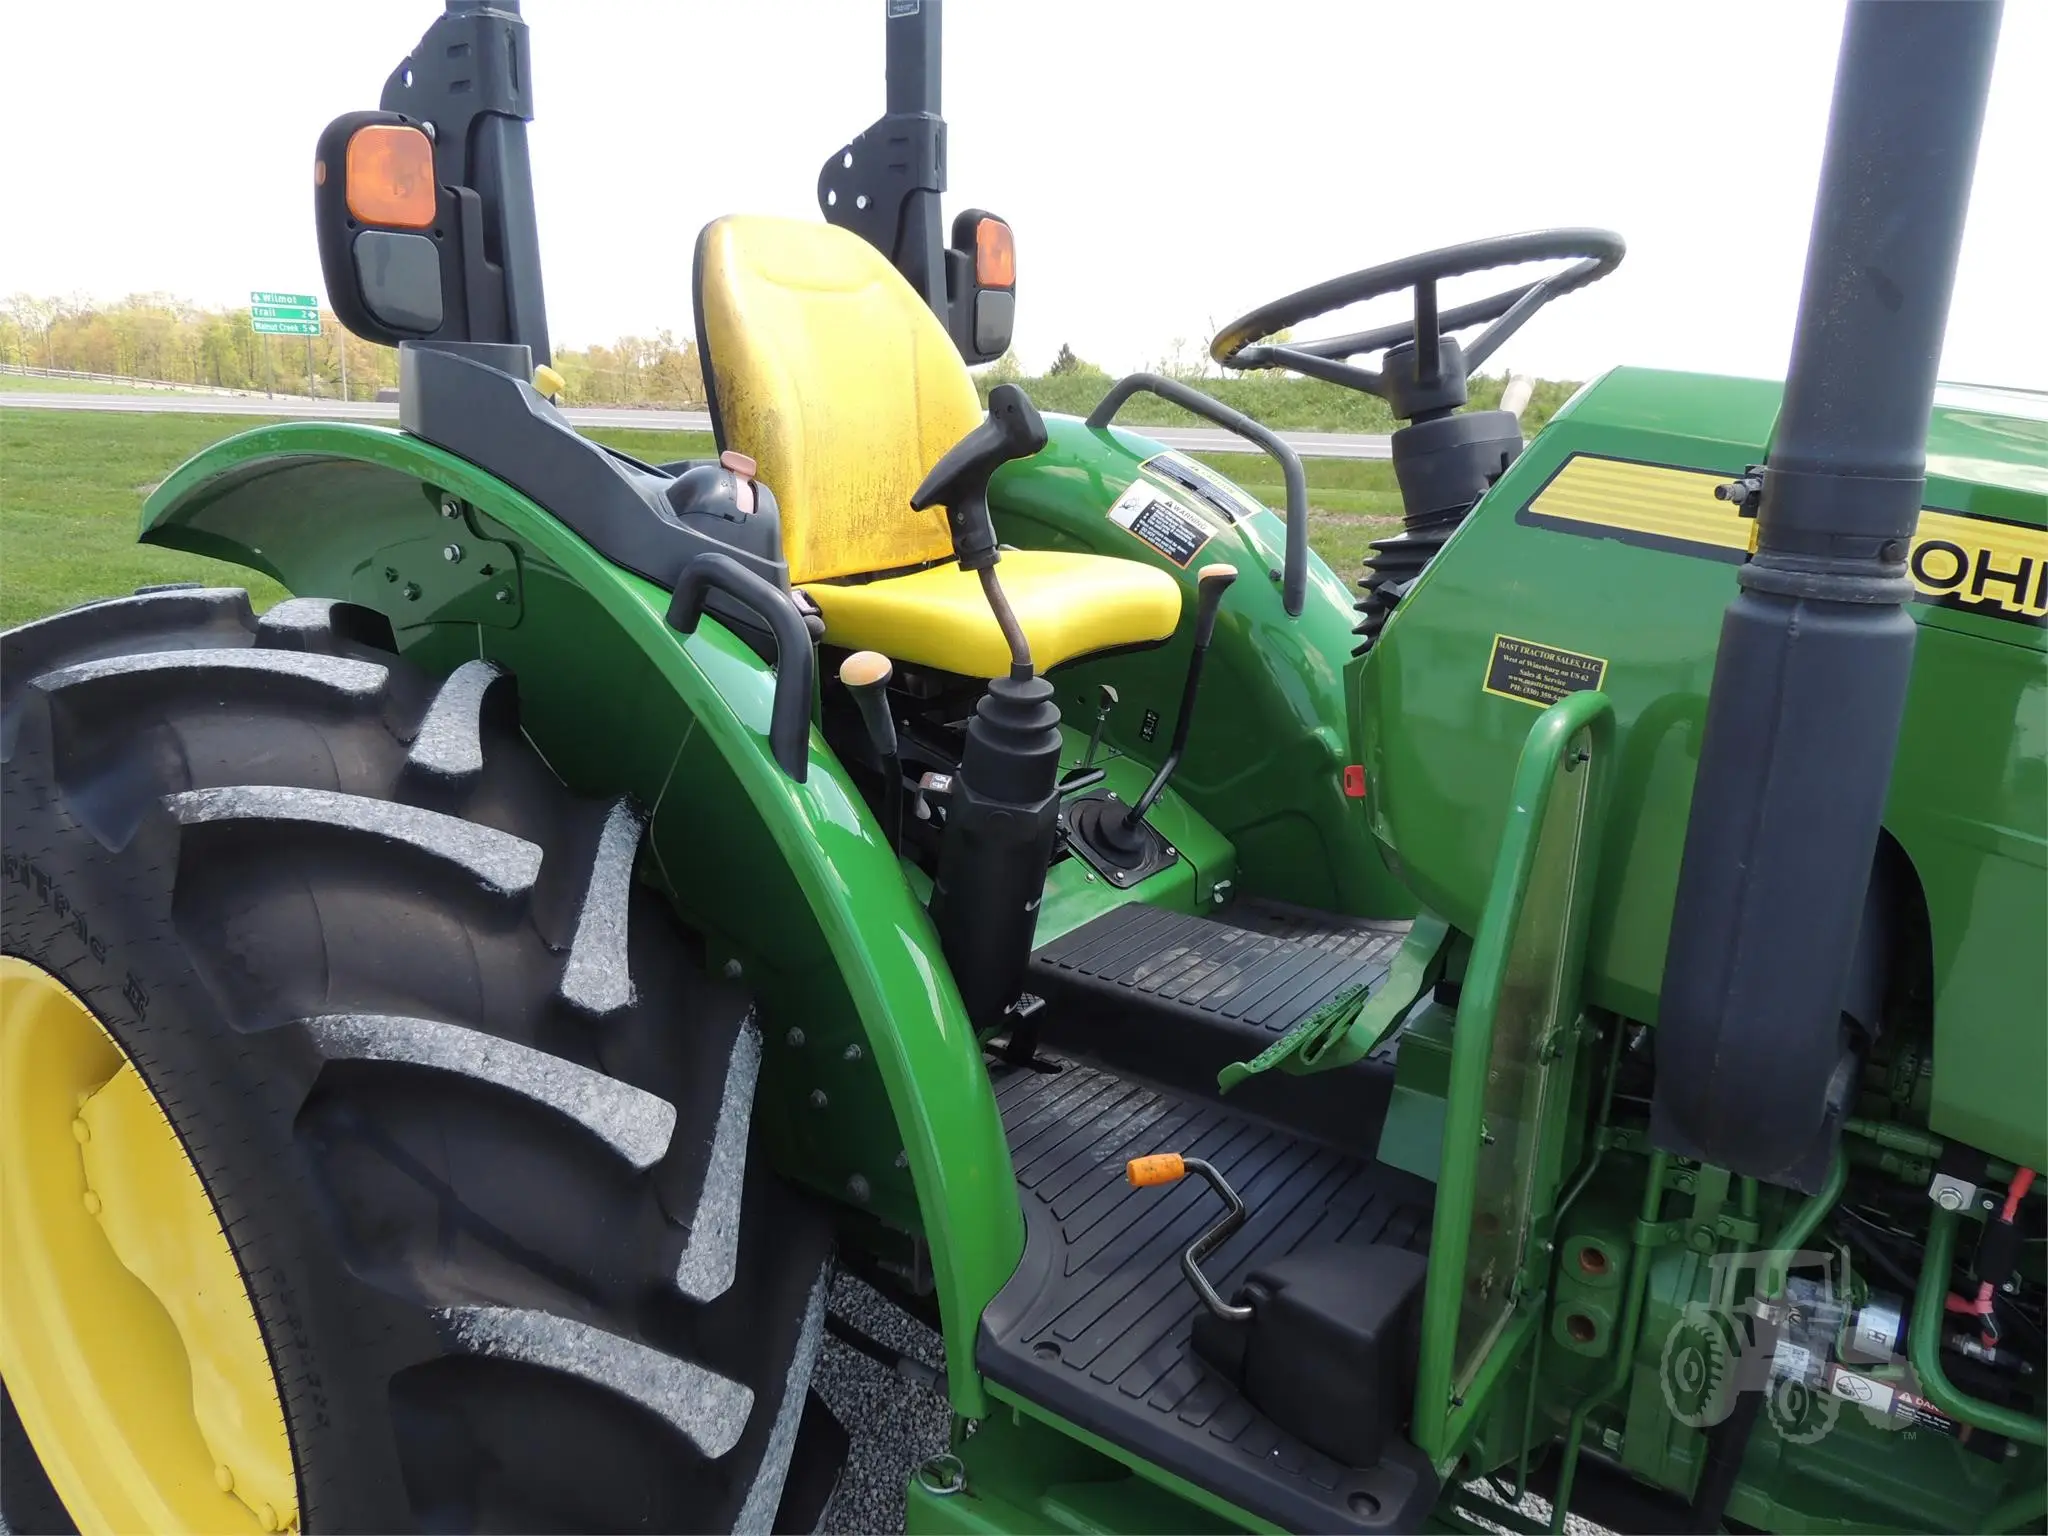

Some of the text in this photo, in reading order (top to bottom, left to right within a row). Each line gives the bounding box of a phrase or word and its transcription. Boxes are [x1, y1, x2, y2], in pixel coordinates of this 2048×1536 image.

[262, 294, 297, 304] Wilmot
[254, 308, 276, 317] Trail
[255, 322, 278, 331] Walnut
[279, 323, 299, 332] Creek
[1173, 503, 1209, 530] WARNING
[1498, 640, 1519, 653] MAST
[1520, 646, 1555, 661] TRACTOR
[1556, 655, 1581, 668] SALES,
[1503, 654, 1518, 664] West
[1570, 671, 1580, 679] US
[1519, 669, 1535, 679] Sales
[1543, 675, 1567, 687] Service
